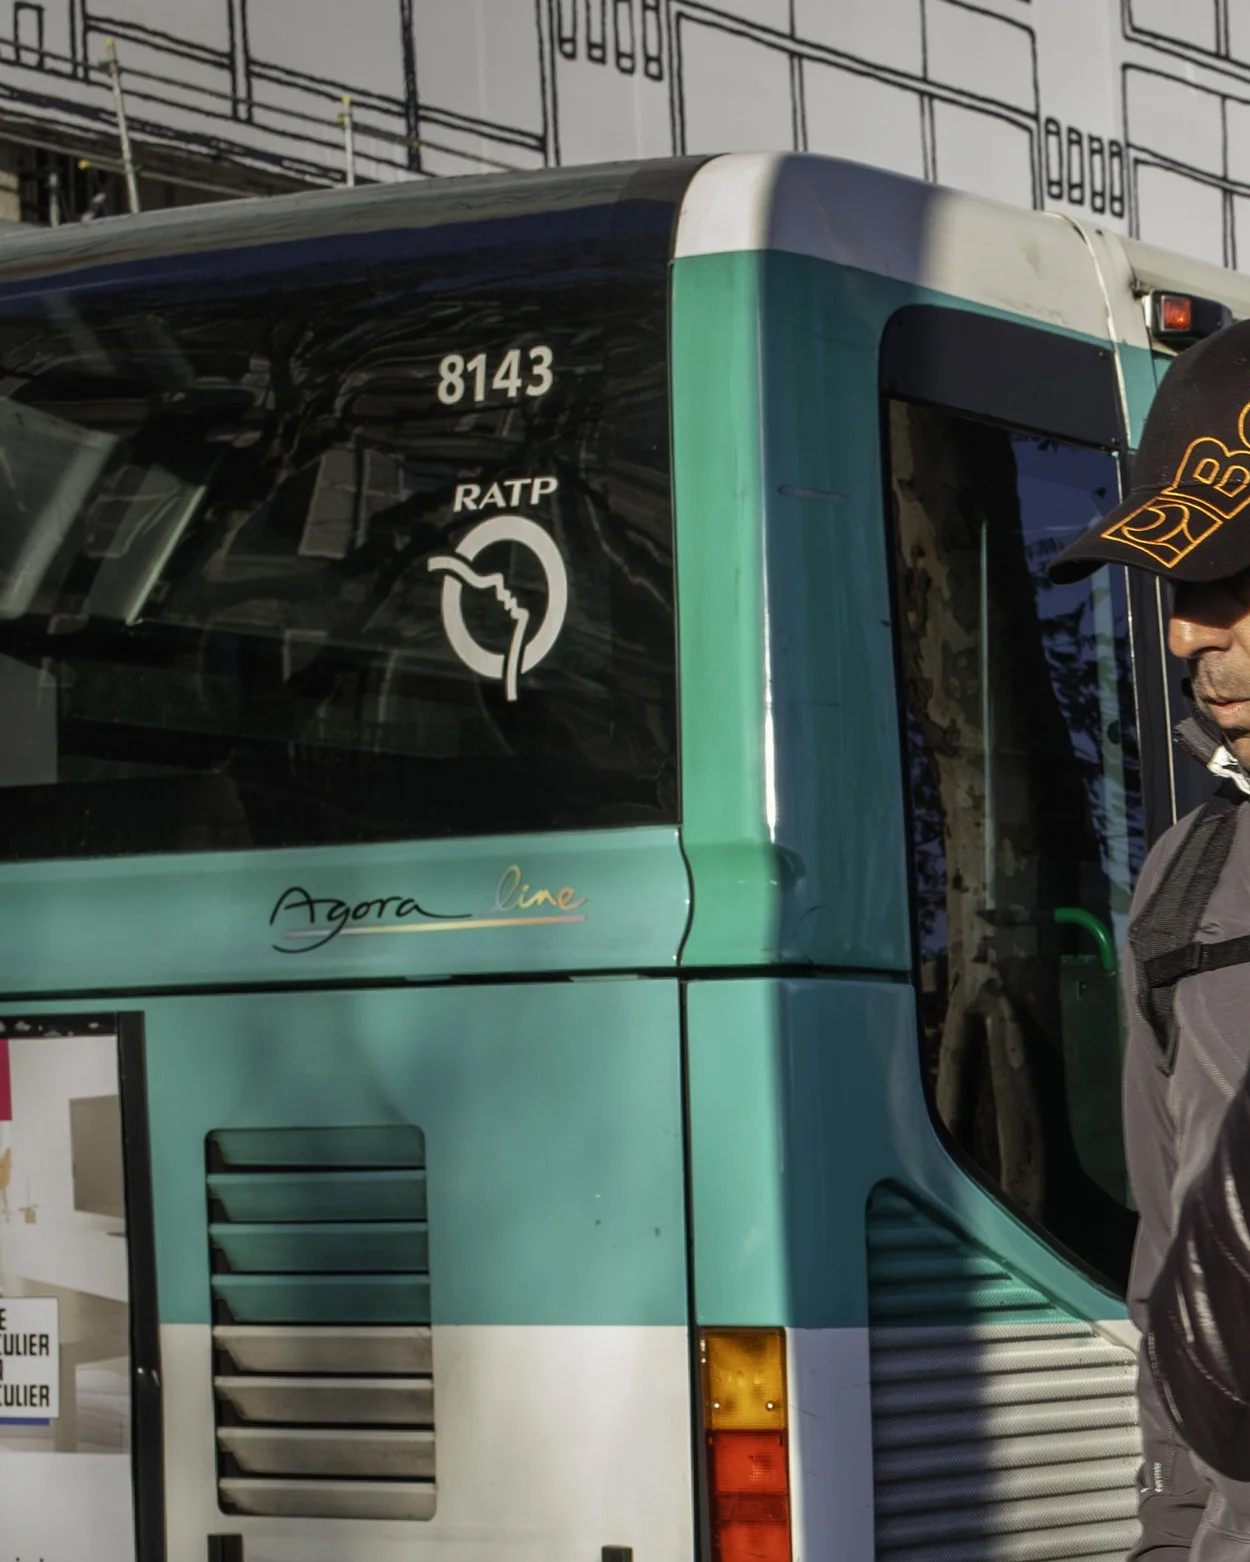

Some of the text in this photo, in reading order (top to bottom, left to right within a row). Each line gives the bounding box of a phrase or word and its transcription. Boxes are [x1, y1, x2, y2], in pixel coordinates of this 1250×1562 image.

[437, 345, 553, 405] 8143
[453, 476, 558, 512] RATP
[269, 864, 589, 954] Agora line
[0, 1333, 49, 1357] ULIER
[0, 1384, 49, 1408] ULIER
